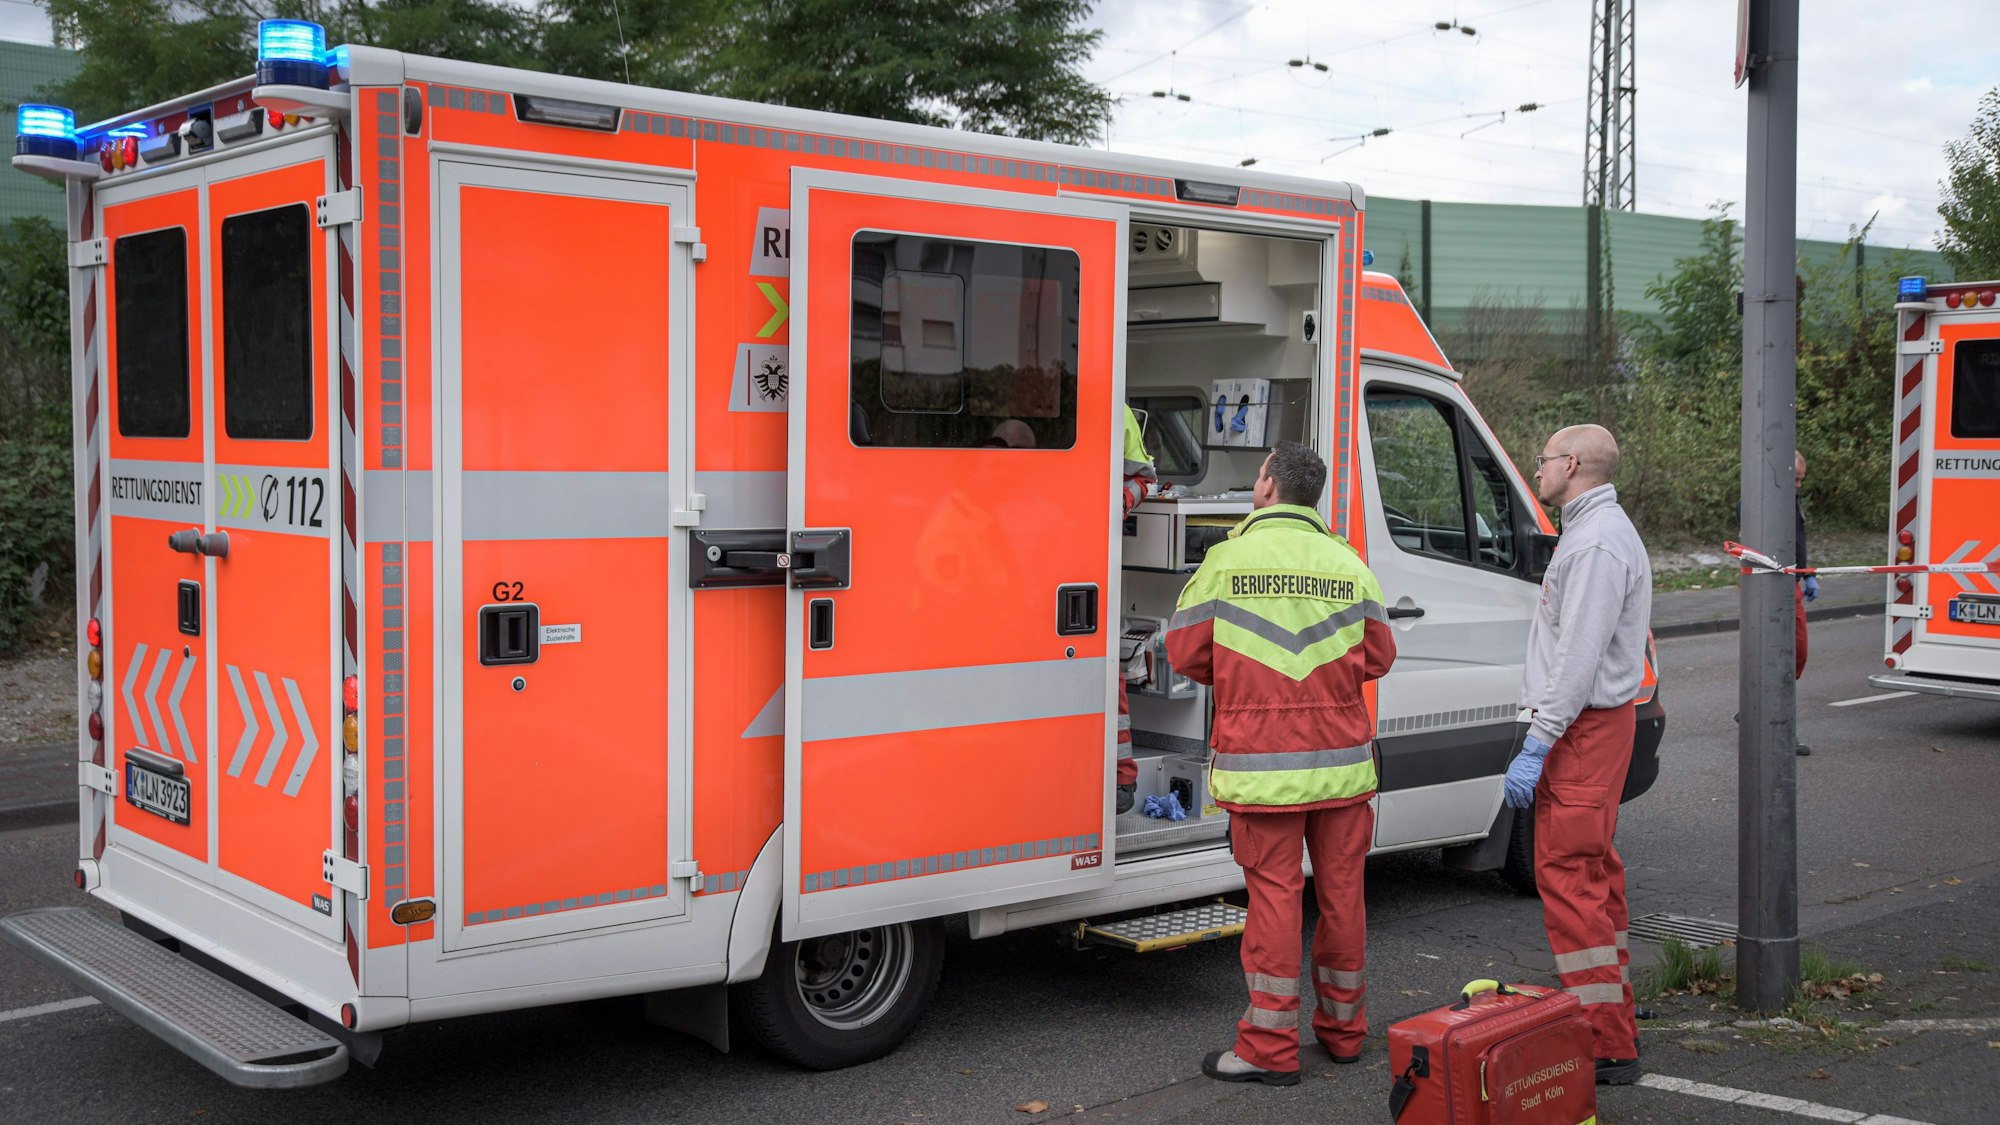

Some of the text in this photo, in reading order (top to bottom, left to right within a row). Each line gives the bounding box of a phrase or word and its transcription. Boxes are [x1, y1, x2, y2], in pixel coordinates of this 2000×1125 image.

[112, 476, 202, 505] RETTUNGSDIENST
[286, 475, 325, 528] 112
[492, 581, 524, 602] G2
[1232, 574, 1354, 600] BERUFSFEUERWEHR
[545, 626, 576, 634] Elektrische
[545, 634, 576, 642] Zuziehhilfe
[1075, 855, 1098, 866] WAS
[313, 896, 330, 912] WAS
[1504, 1057, 1580, 1100] RETTUNGSDIENST
[1521, 1085, 1565, 1110] Stadt Köln
